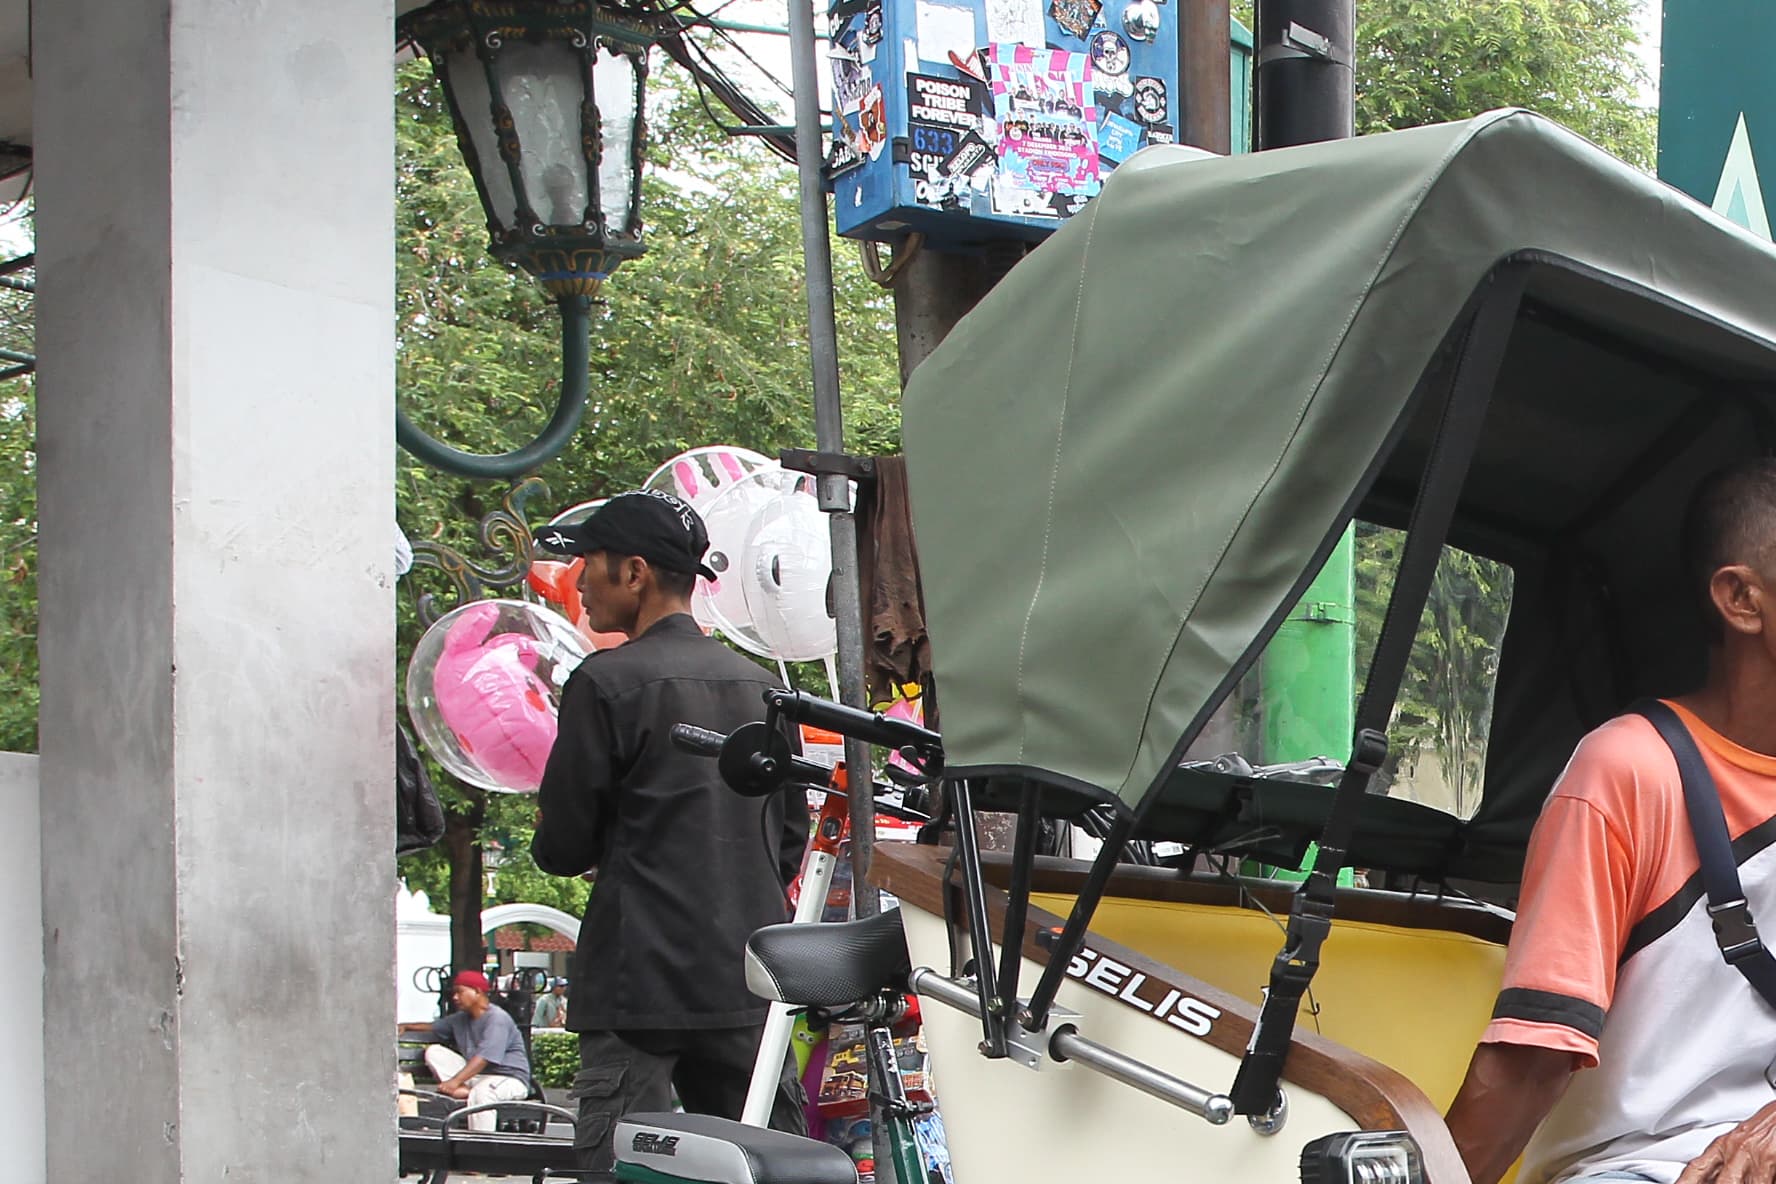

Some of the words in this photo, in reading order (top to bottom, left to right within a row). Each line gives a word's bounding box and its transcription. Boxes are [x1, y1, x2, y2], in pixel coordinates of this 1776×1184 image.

[916, 79, 970, 100] POISON
[921, 93, 966, 112] TRIBE
[912, 105, 977, 128] FOREVER
[914, 128, 954, 155] 633
[1067, 949, 1221, 1038] SELIS
